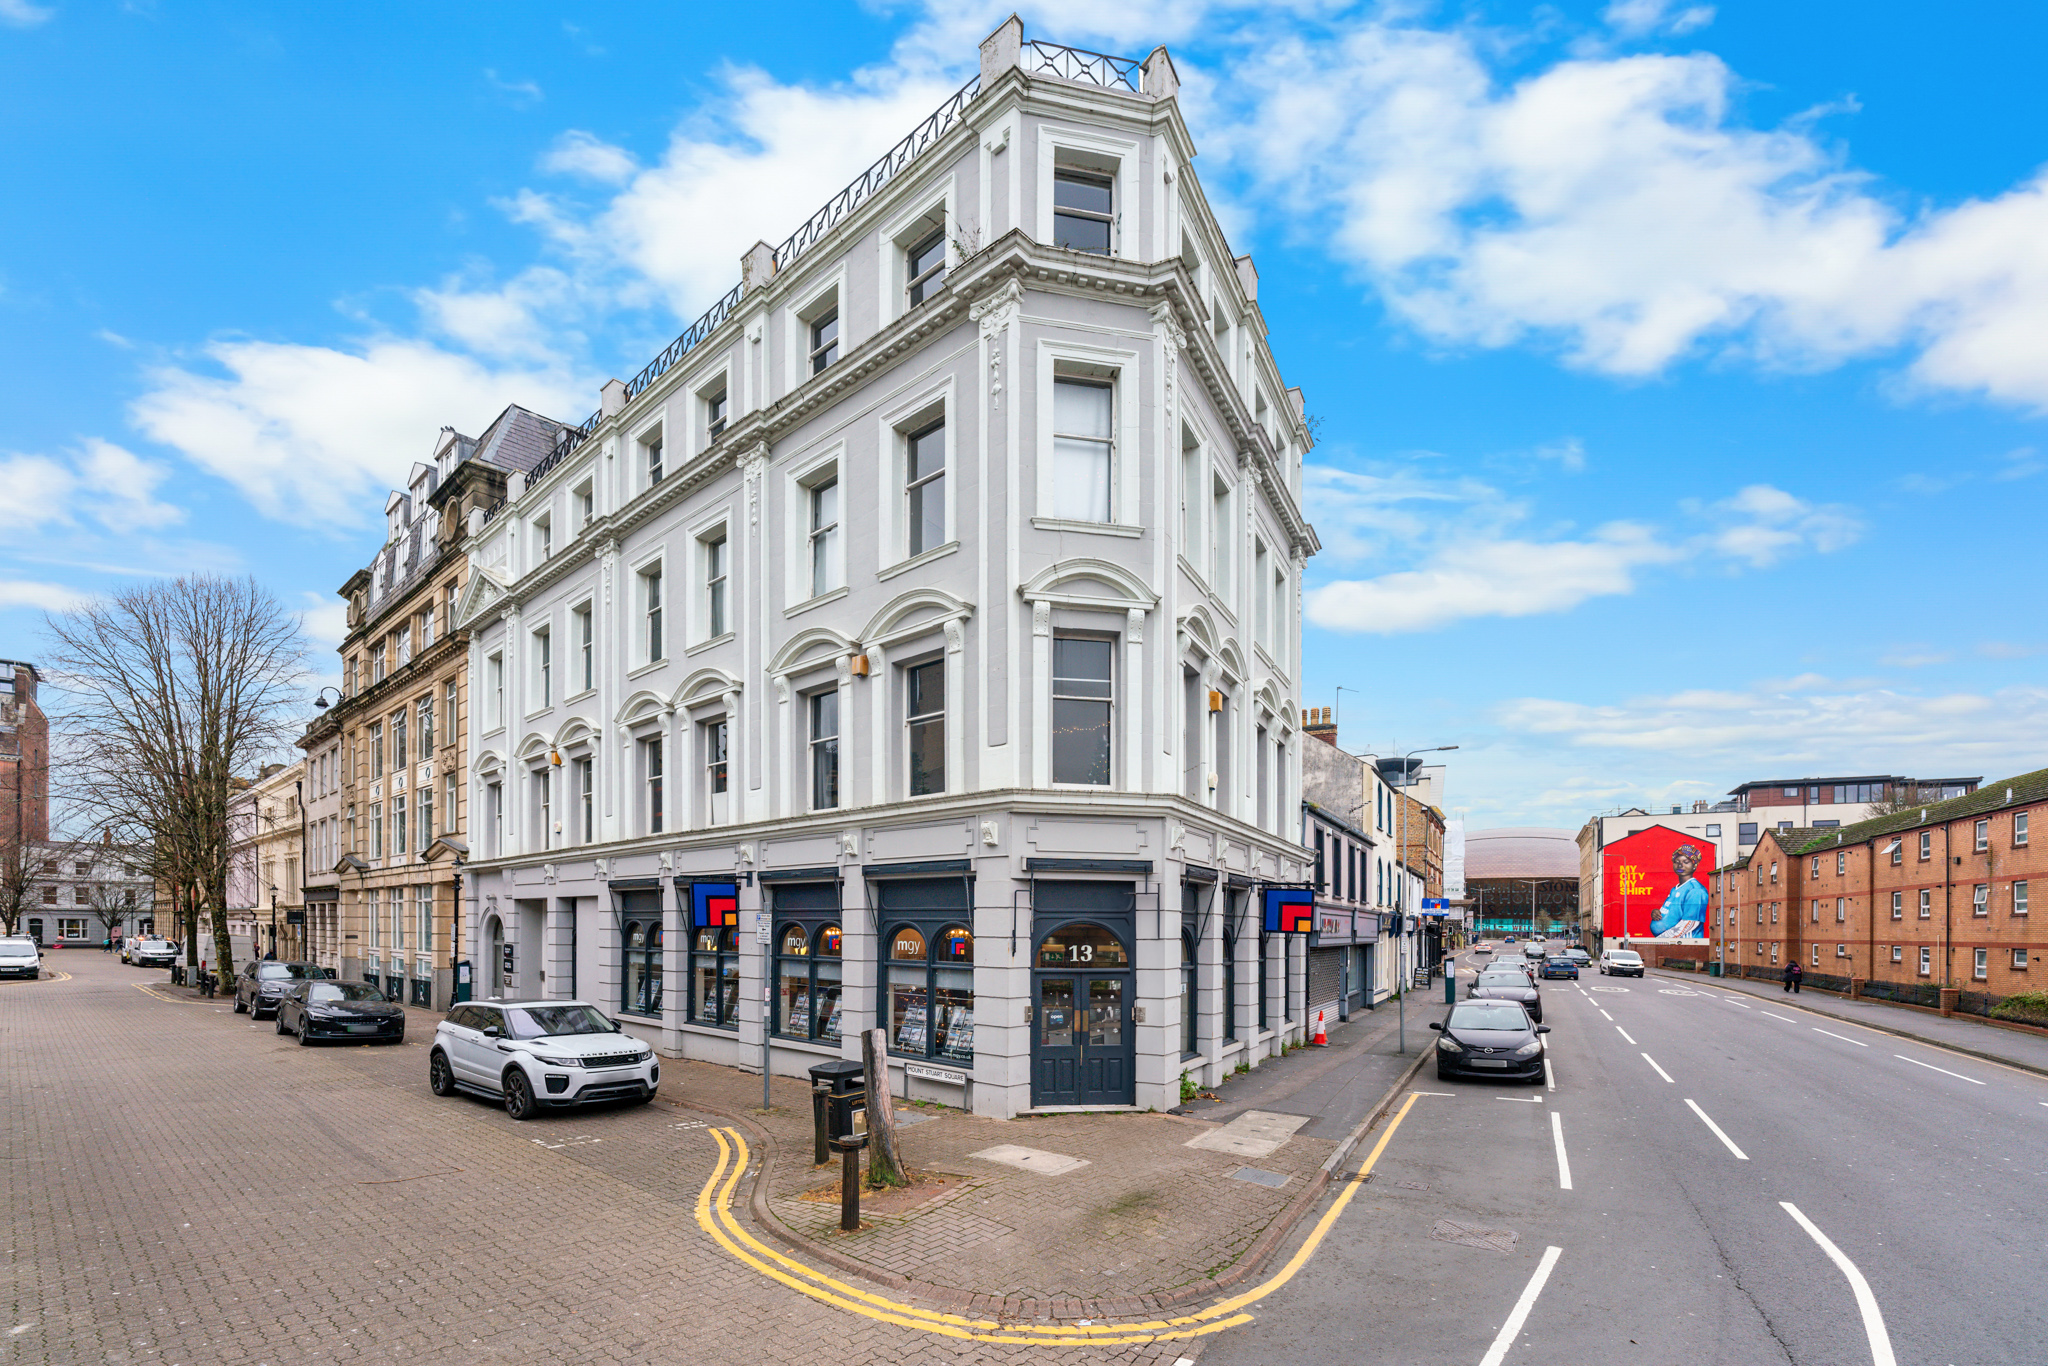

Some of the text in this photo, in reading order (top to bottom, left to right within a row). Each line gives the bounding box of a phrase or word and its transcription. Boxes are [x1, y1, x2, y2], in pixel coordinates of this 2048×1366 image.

[1620, 865, 1637, 873] MY
[1620, 872, 1645, 880] CITY
[1620, 880, 1637, 888] MY
[1620, 887, 1653, 895] SHIRT
[633, 933, 644, 943] mgy
[700, 934, 715, 946] mgy
[787, 937, 806, 949] mgy
[897, 940, 921, 954] mgy
[1069, 945, 1093, 962] 13
[907, 1066, 964, 1082] MOUNT STUART SQUARE
